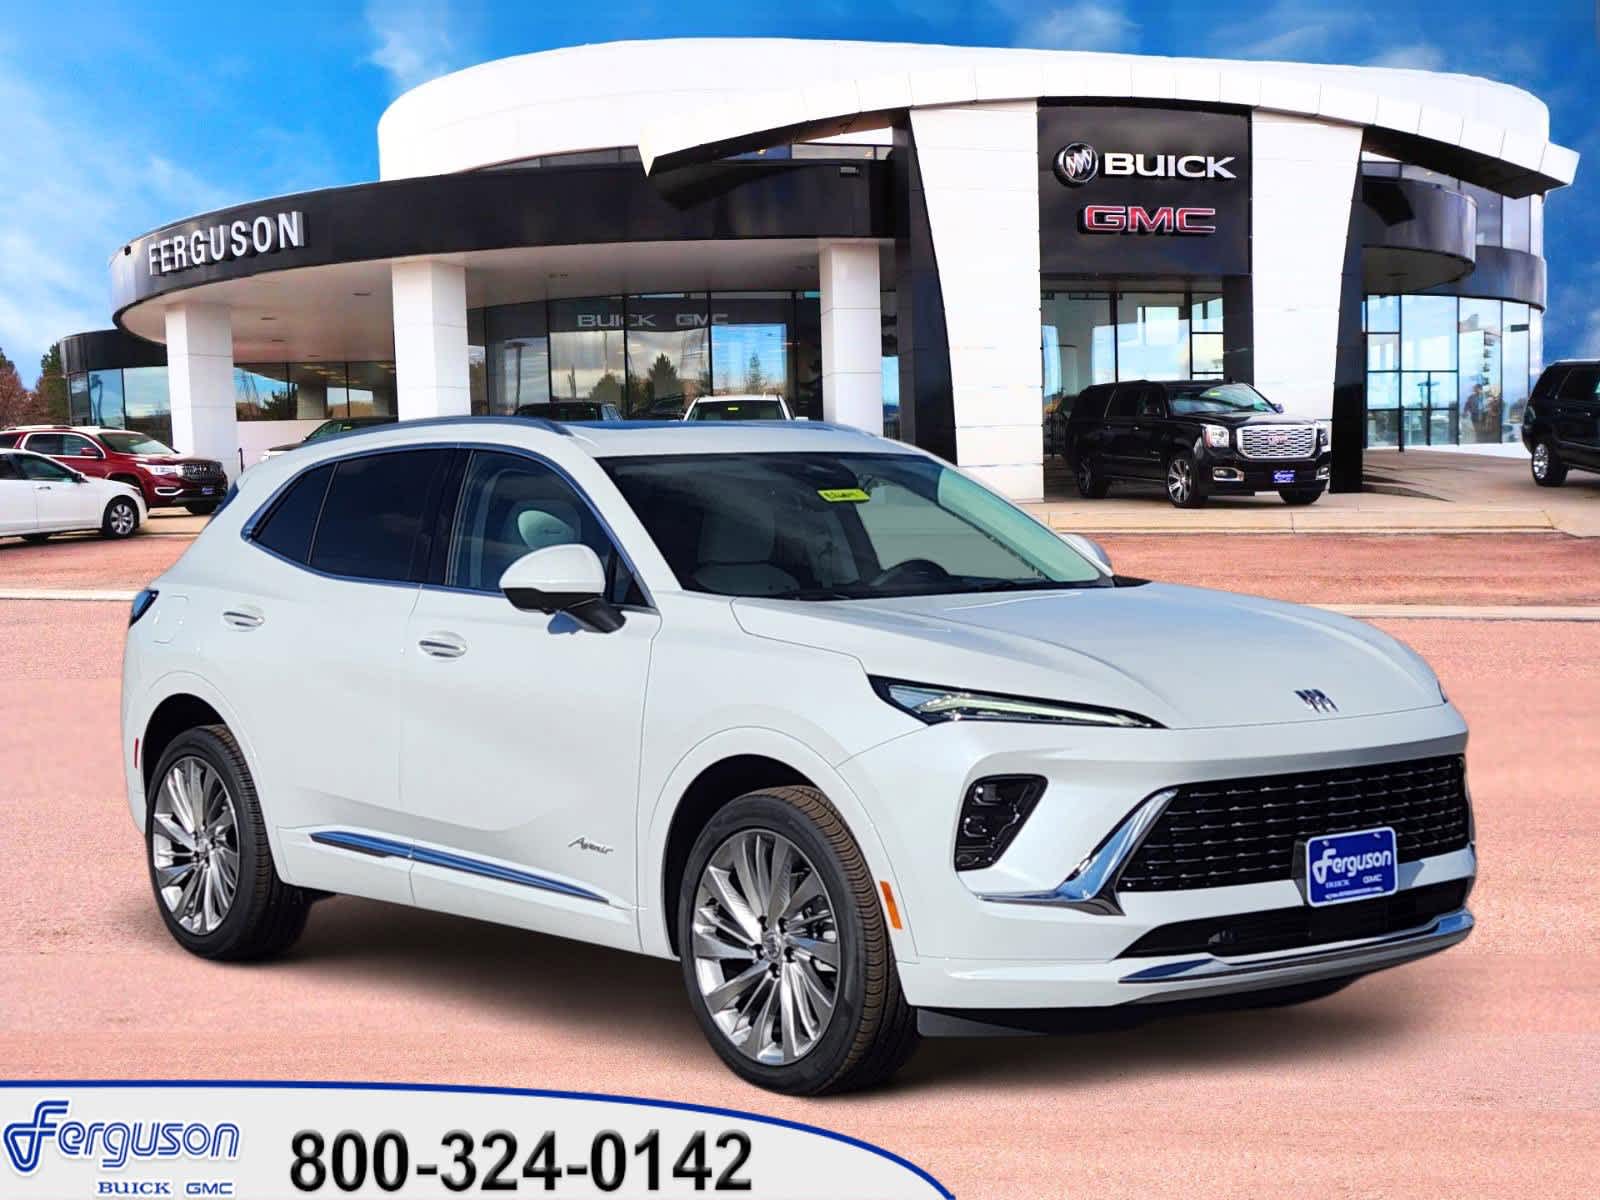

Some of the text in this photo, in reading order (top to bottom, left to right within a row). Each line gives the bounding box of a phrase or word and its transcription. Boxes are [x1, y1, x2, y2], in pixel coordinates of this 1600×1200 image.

[1104, 152, 1237, 179] BUICK
[1084, 204, 1216, 233] GMC
[148, 210, 304, 276] FERGUSON
[577, 313, 656, 327] BUICK
[1312, 848, 1392, 885] Ferguson
